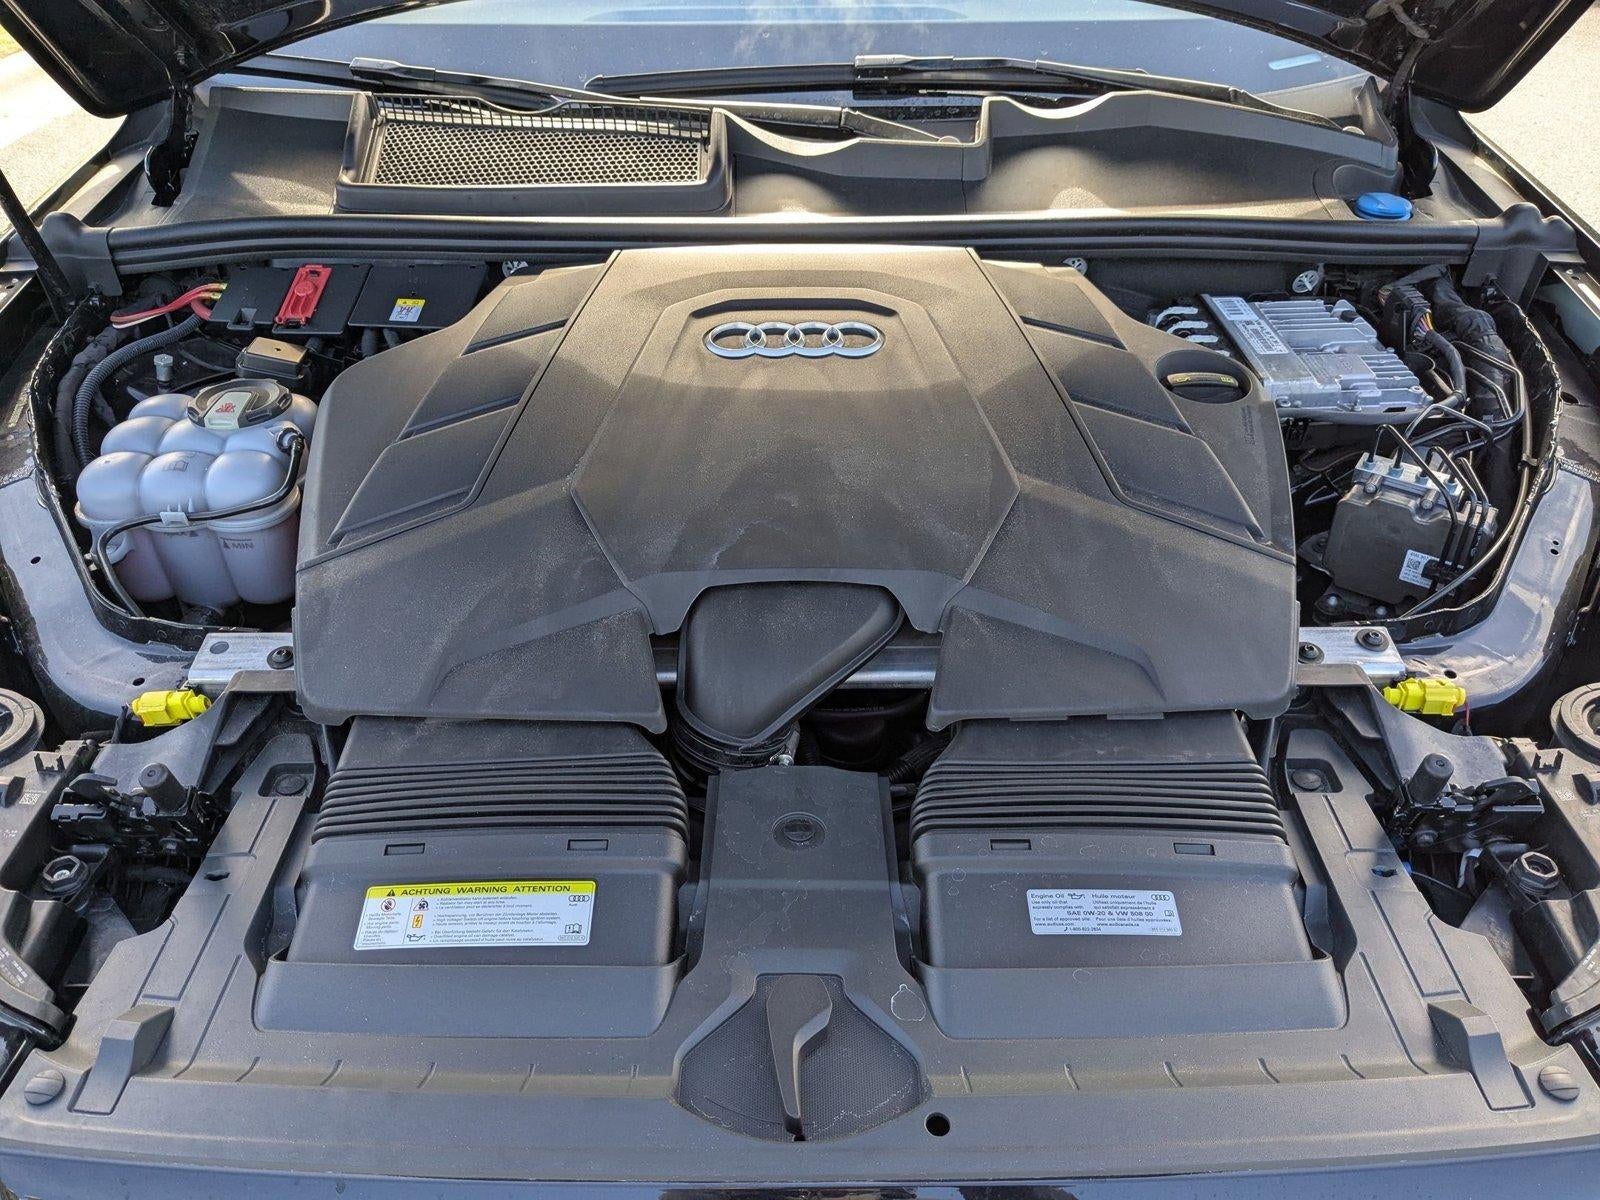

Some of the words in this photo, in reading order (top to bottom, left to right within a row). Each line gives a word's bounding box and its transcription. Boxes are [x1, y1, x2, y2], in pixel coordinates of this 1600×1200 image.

[400, 888, 450, 896] ACHTUNG
[456, 886, 508, 894] WARNING
[513, 885, 571, 893] ATTENTION
